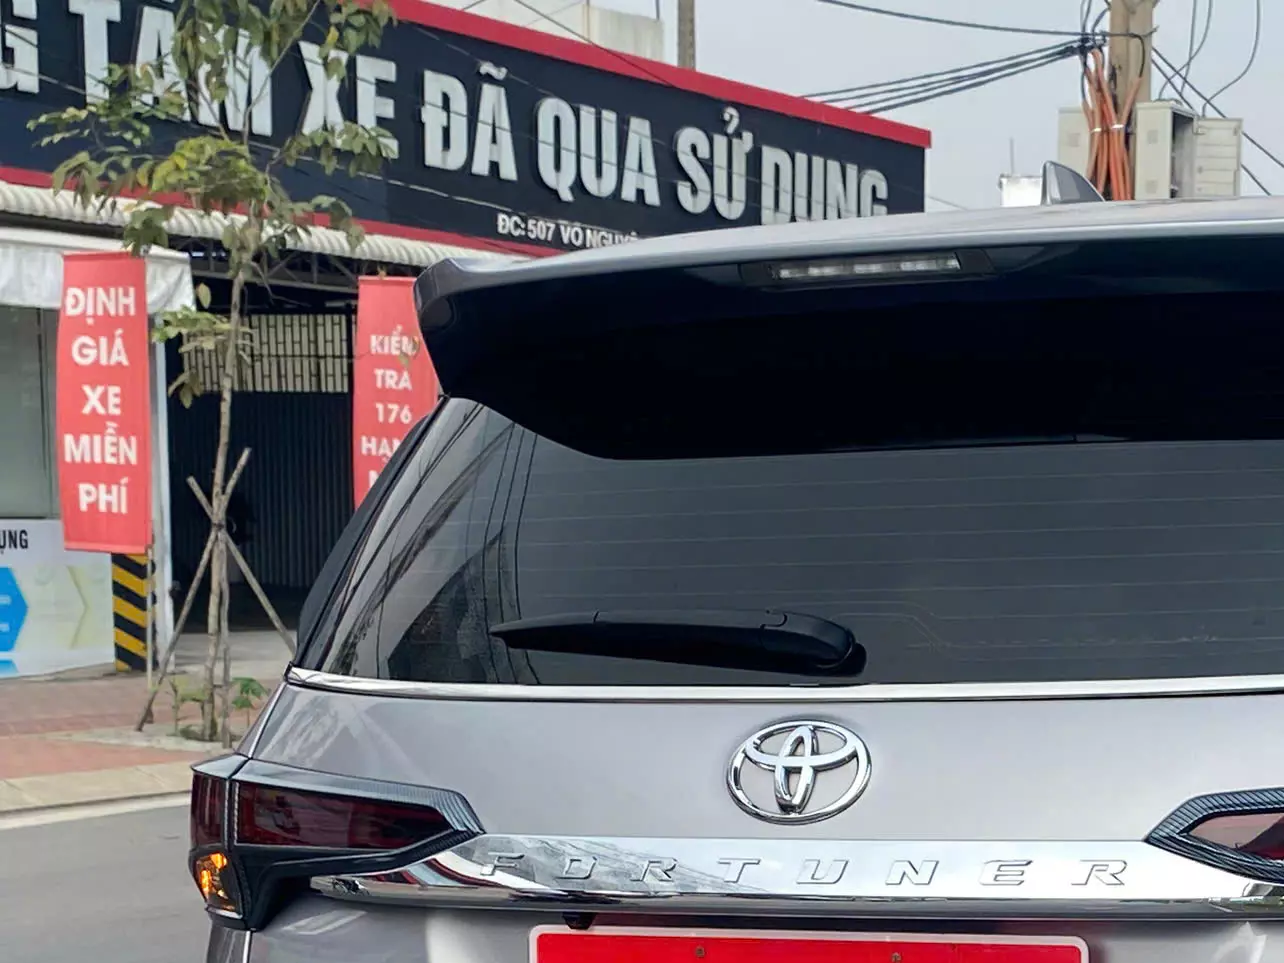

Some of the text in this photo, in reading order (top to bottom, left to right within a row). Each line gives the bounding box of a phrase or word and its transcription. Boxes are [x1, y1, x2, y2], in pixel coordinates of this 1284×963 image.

[298, 40, 399, 159] XE
[421, 61, 518, 181] ĐÃ
[537, 97, 661, 202] QUA
[675, 106, 754, 221] SỬ
[65, 287, 136, 325] ĐỊNH
[71, 329, 129, 366] GIÁ
[374, 368, 412, 391] TRA
[81, 385, 121, 416] XE
[376, 402, 412, 424] 176
[63, 422, 138, 465] MIỄN
[78, 477, 129, 515] PHÍ
[480, 851, 1127, 888] FORTUNER
